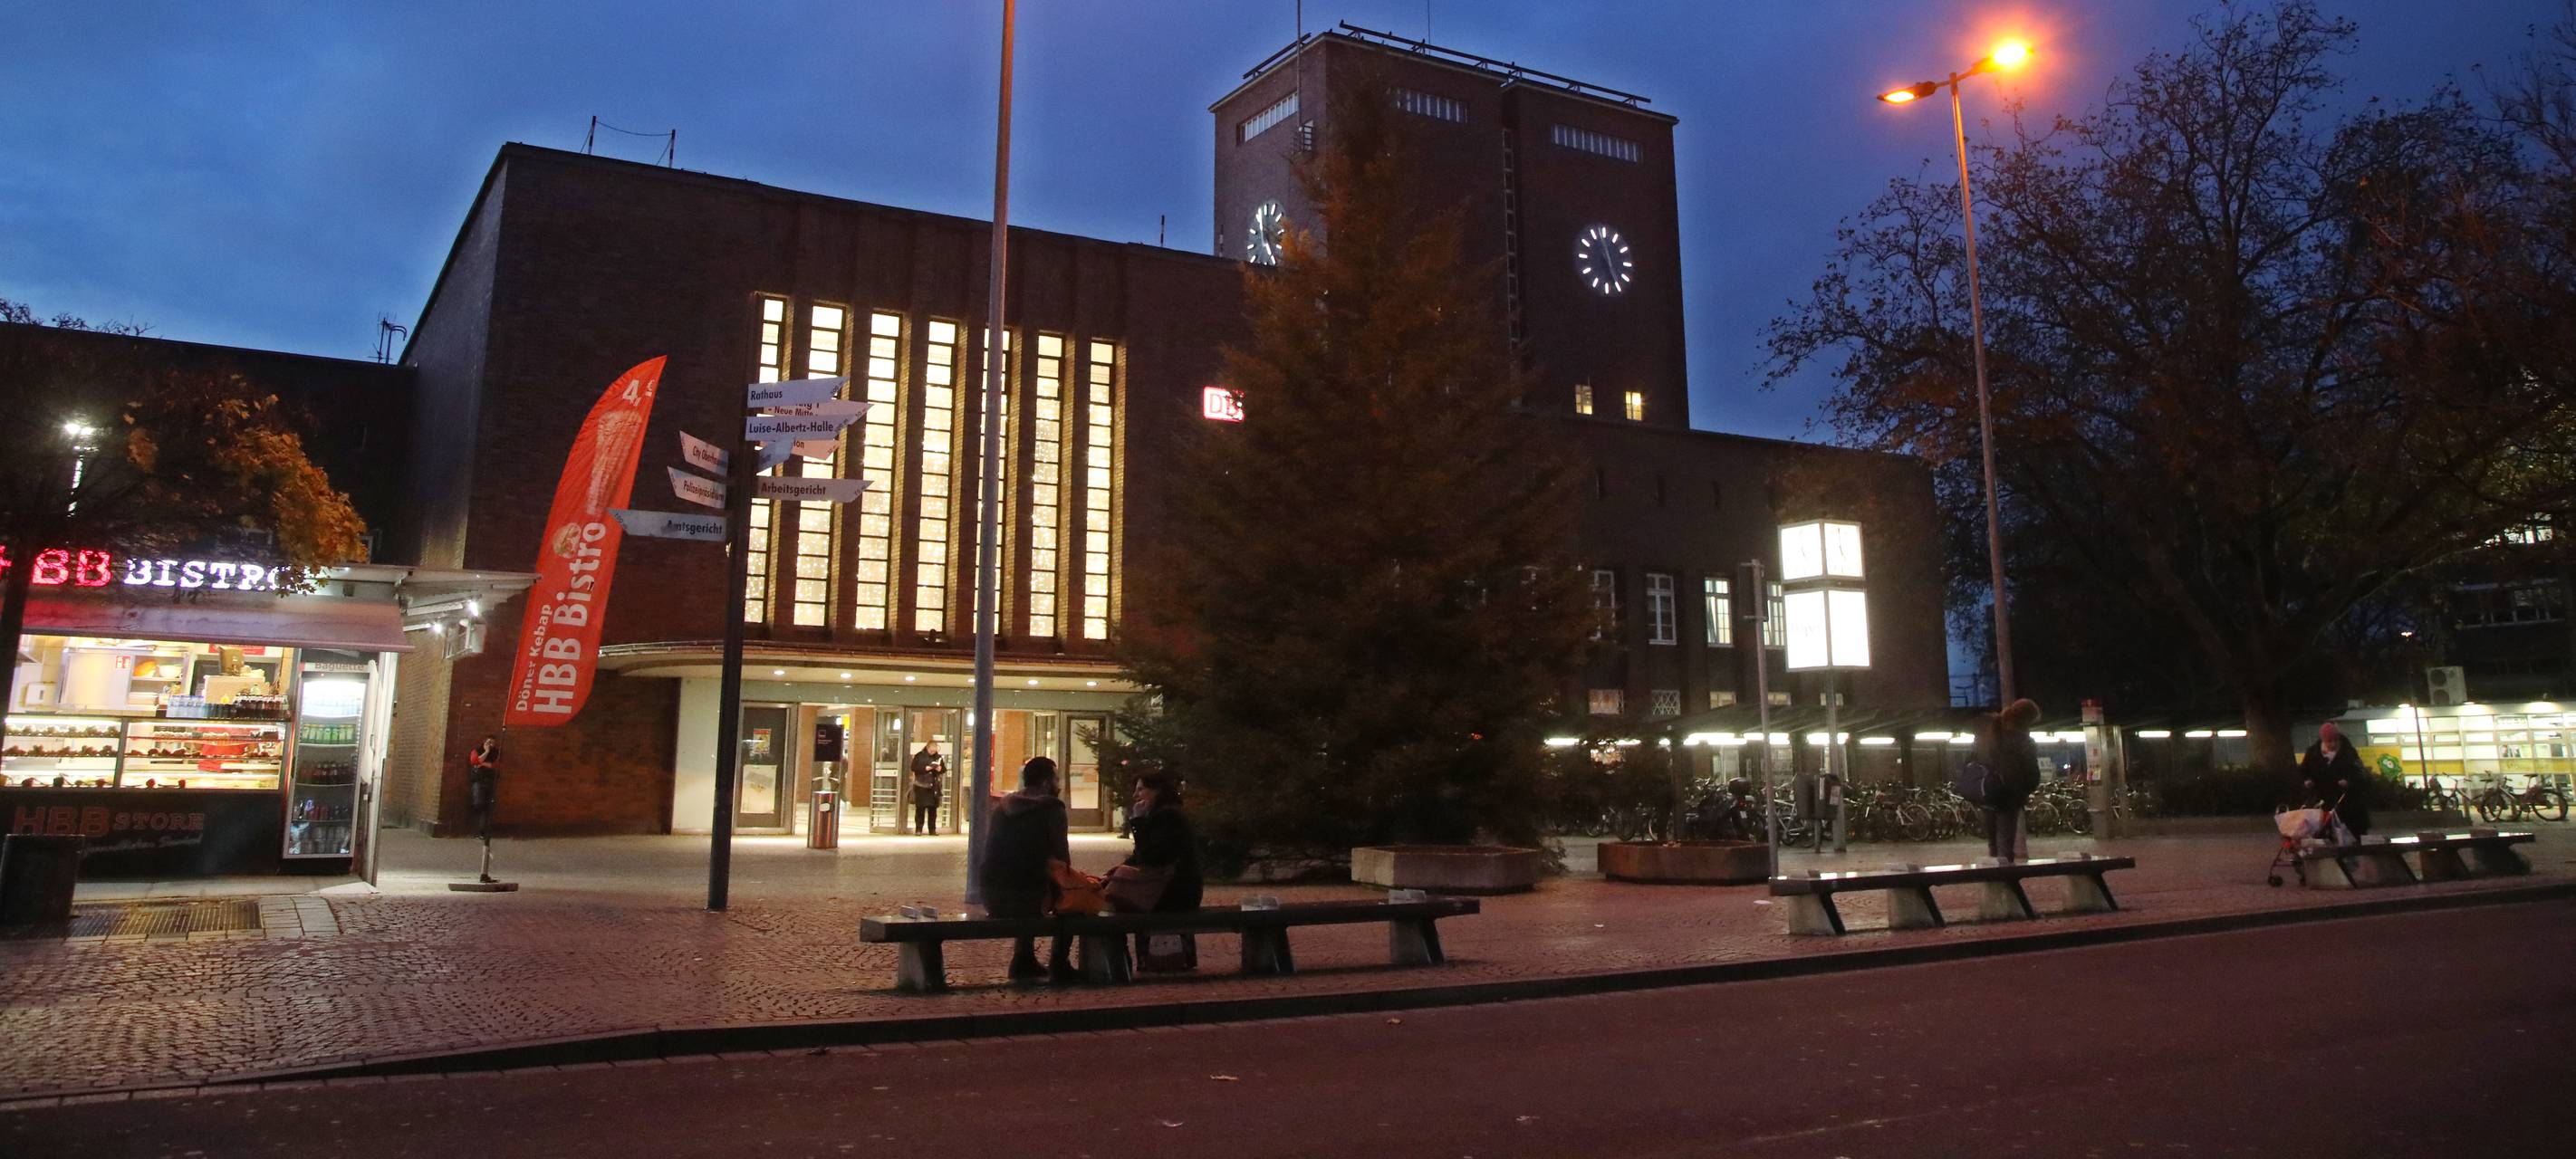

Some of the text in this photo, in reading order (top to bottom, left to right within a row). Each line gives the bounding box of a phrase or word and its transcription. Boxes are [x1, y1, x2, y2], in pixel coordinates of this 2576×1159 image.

[750, 389, 783, 400] Rathaus
[774, 406, 793, 416] Neue
[749, 421, 834, 434] Luise-Albertz-Halle
[761, 483, 826, 496] Arbeitsgericht
[667, 520, 723, 534] Amtsgericht
[533, 522, 606, 714] HBB Bistro
[516, 604, 553, 711] Döner Kebap
[13, 806, 204, 838] HBB STORE
